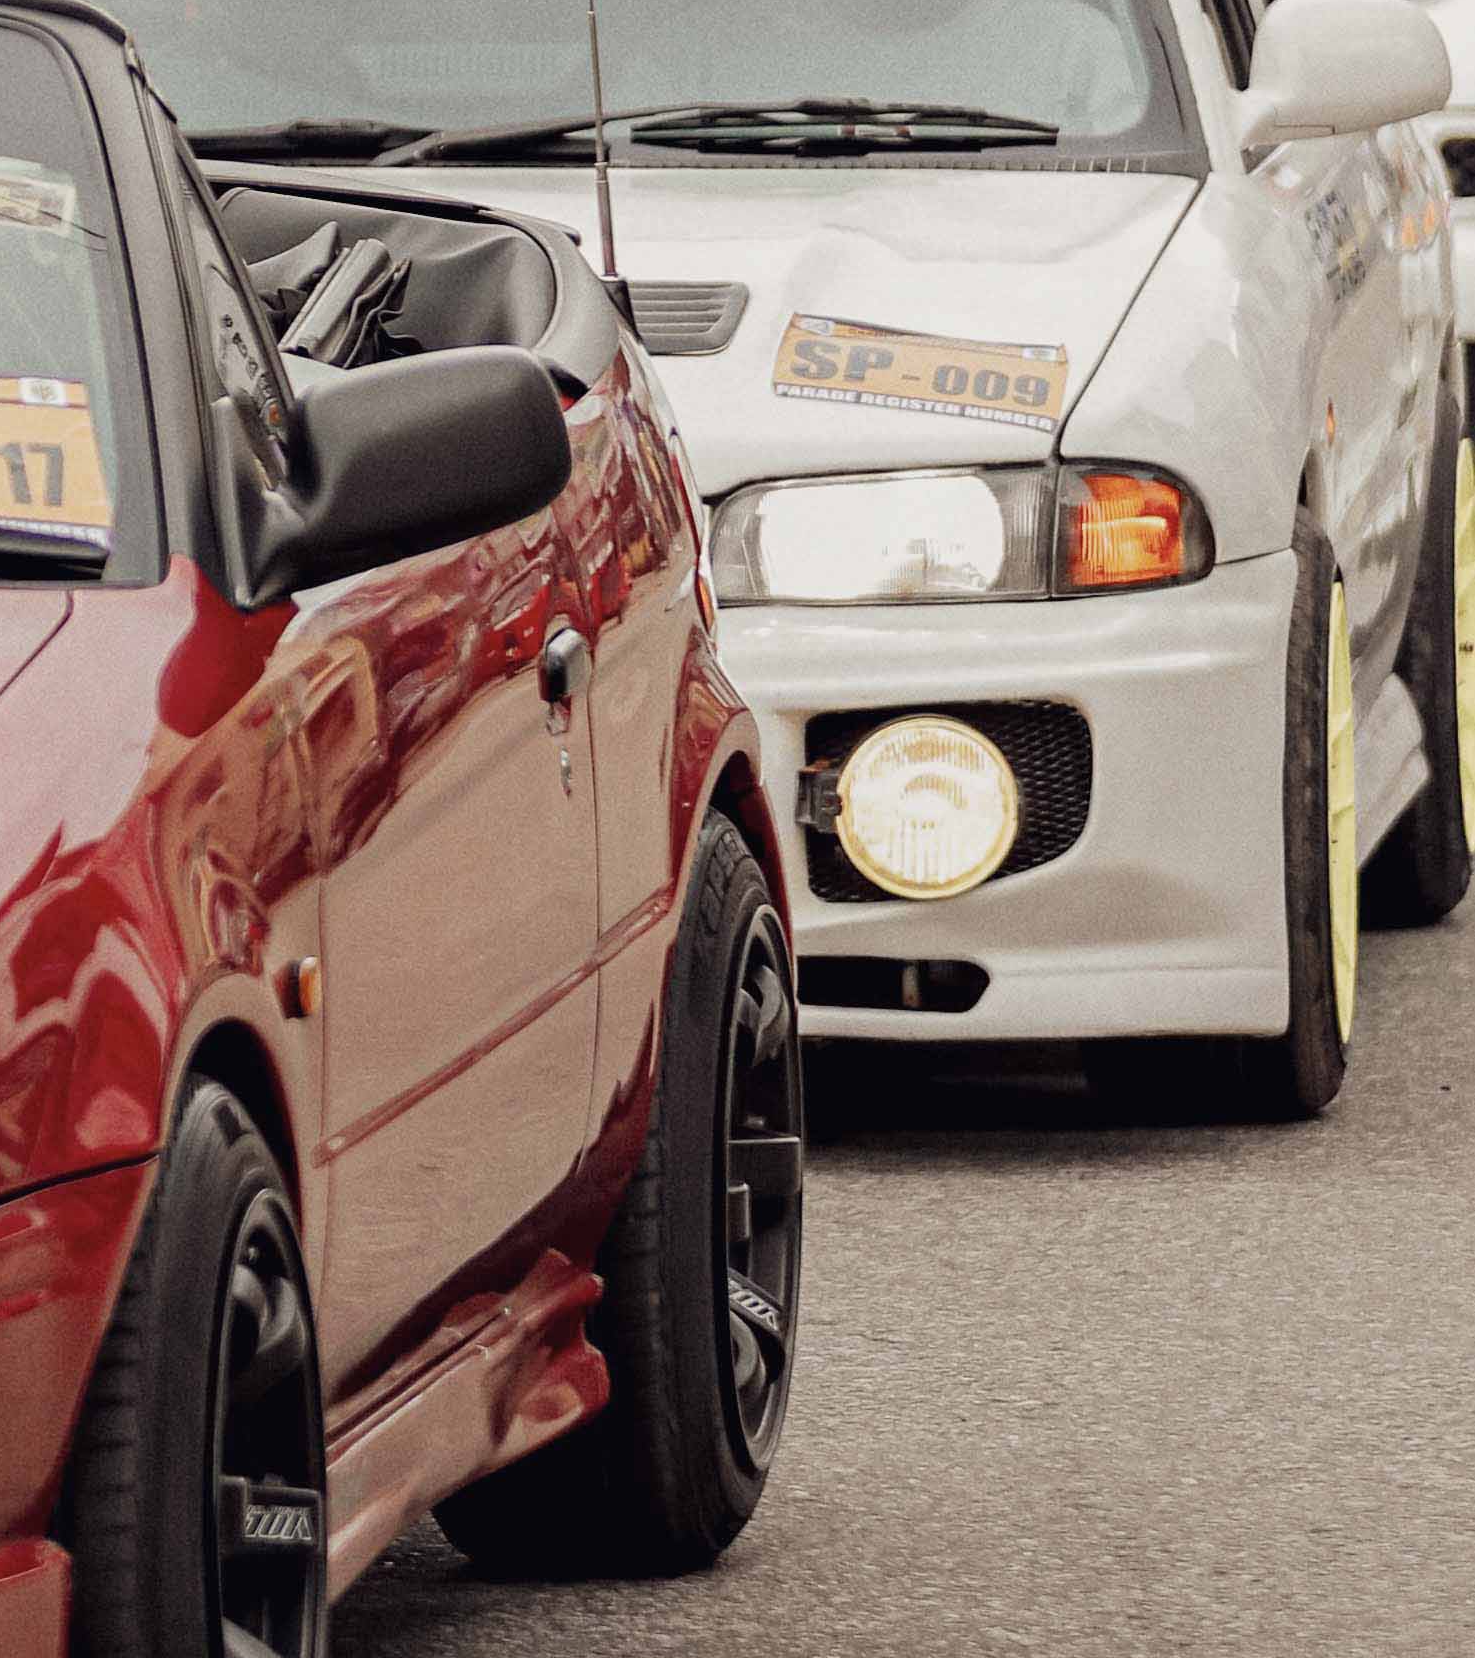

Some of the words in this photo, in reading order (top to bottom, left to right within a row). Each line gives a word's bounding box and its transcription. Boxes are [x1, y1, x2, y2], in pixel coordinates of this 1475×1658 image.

[776, 384, 859, 404] PARADE
[860, 391, 963, 417] REGISTER
[963, 404, 1054, 432] NUMBER
